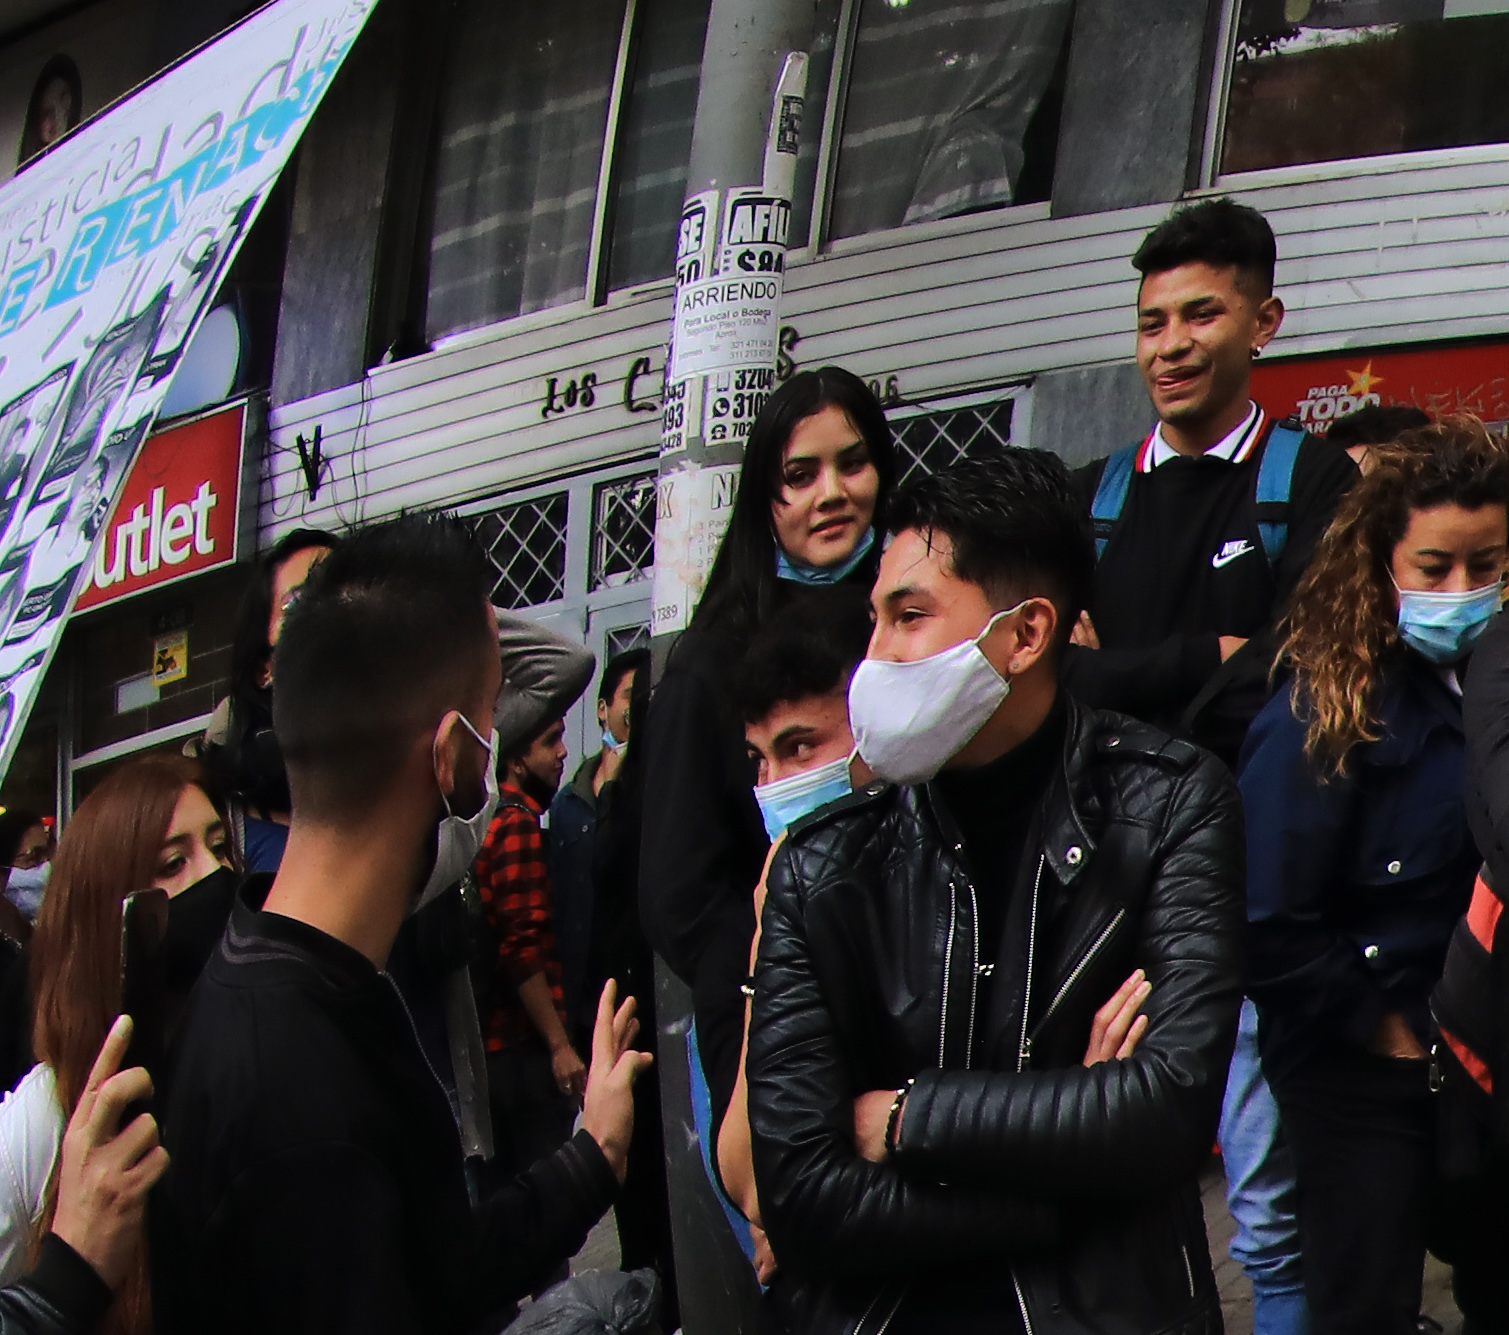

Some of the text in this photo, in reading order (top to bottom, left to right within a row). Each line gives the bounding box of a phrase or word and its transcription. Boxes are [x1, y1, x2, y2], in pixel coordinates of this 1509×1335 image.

[682, 281, 777, 314] ARRIENDO
[704, 310, 731, 323] Local
[732, 311, 740, 320] o
[741, 308, 772, 321] Bodega
[540, 372, 598, 420] Los
[1307, 384, 1349, 398] PAGA
[1296, 392, 1381, 422] TODO
